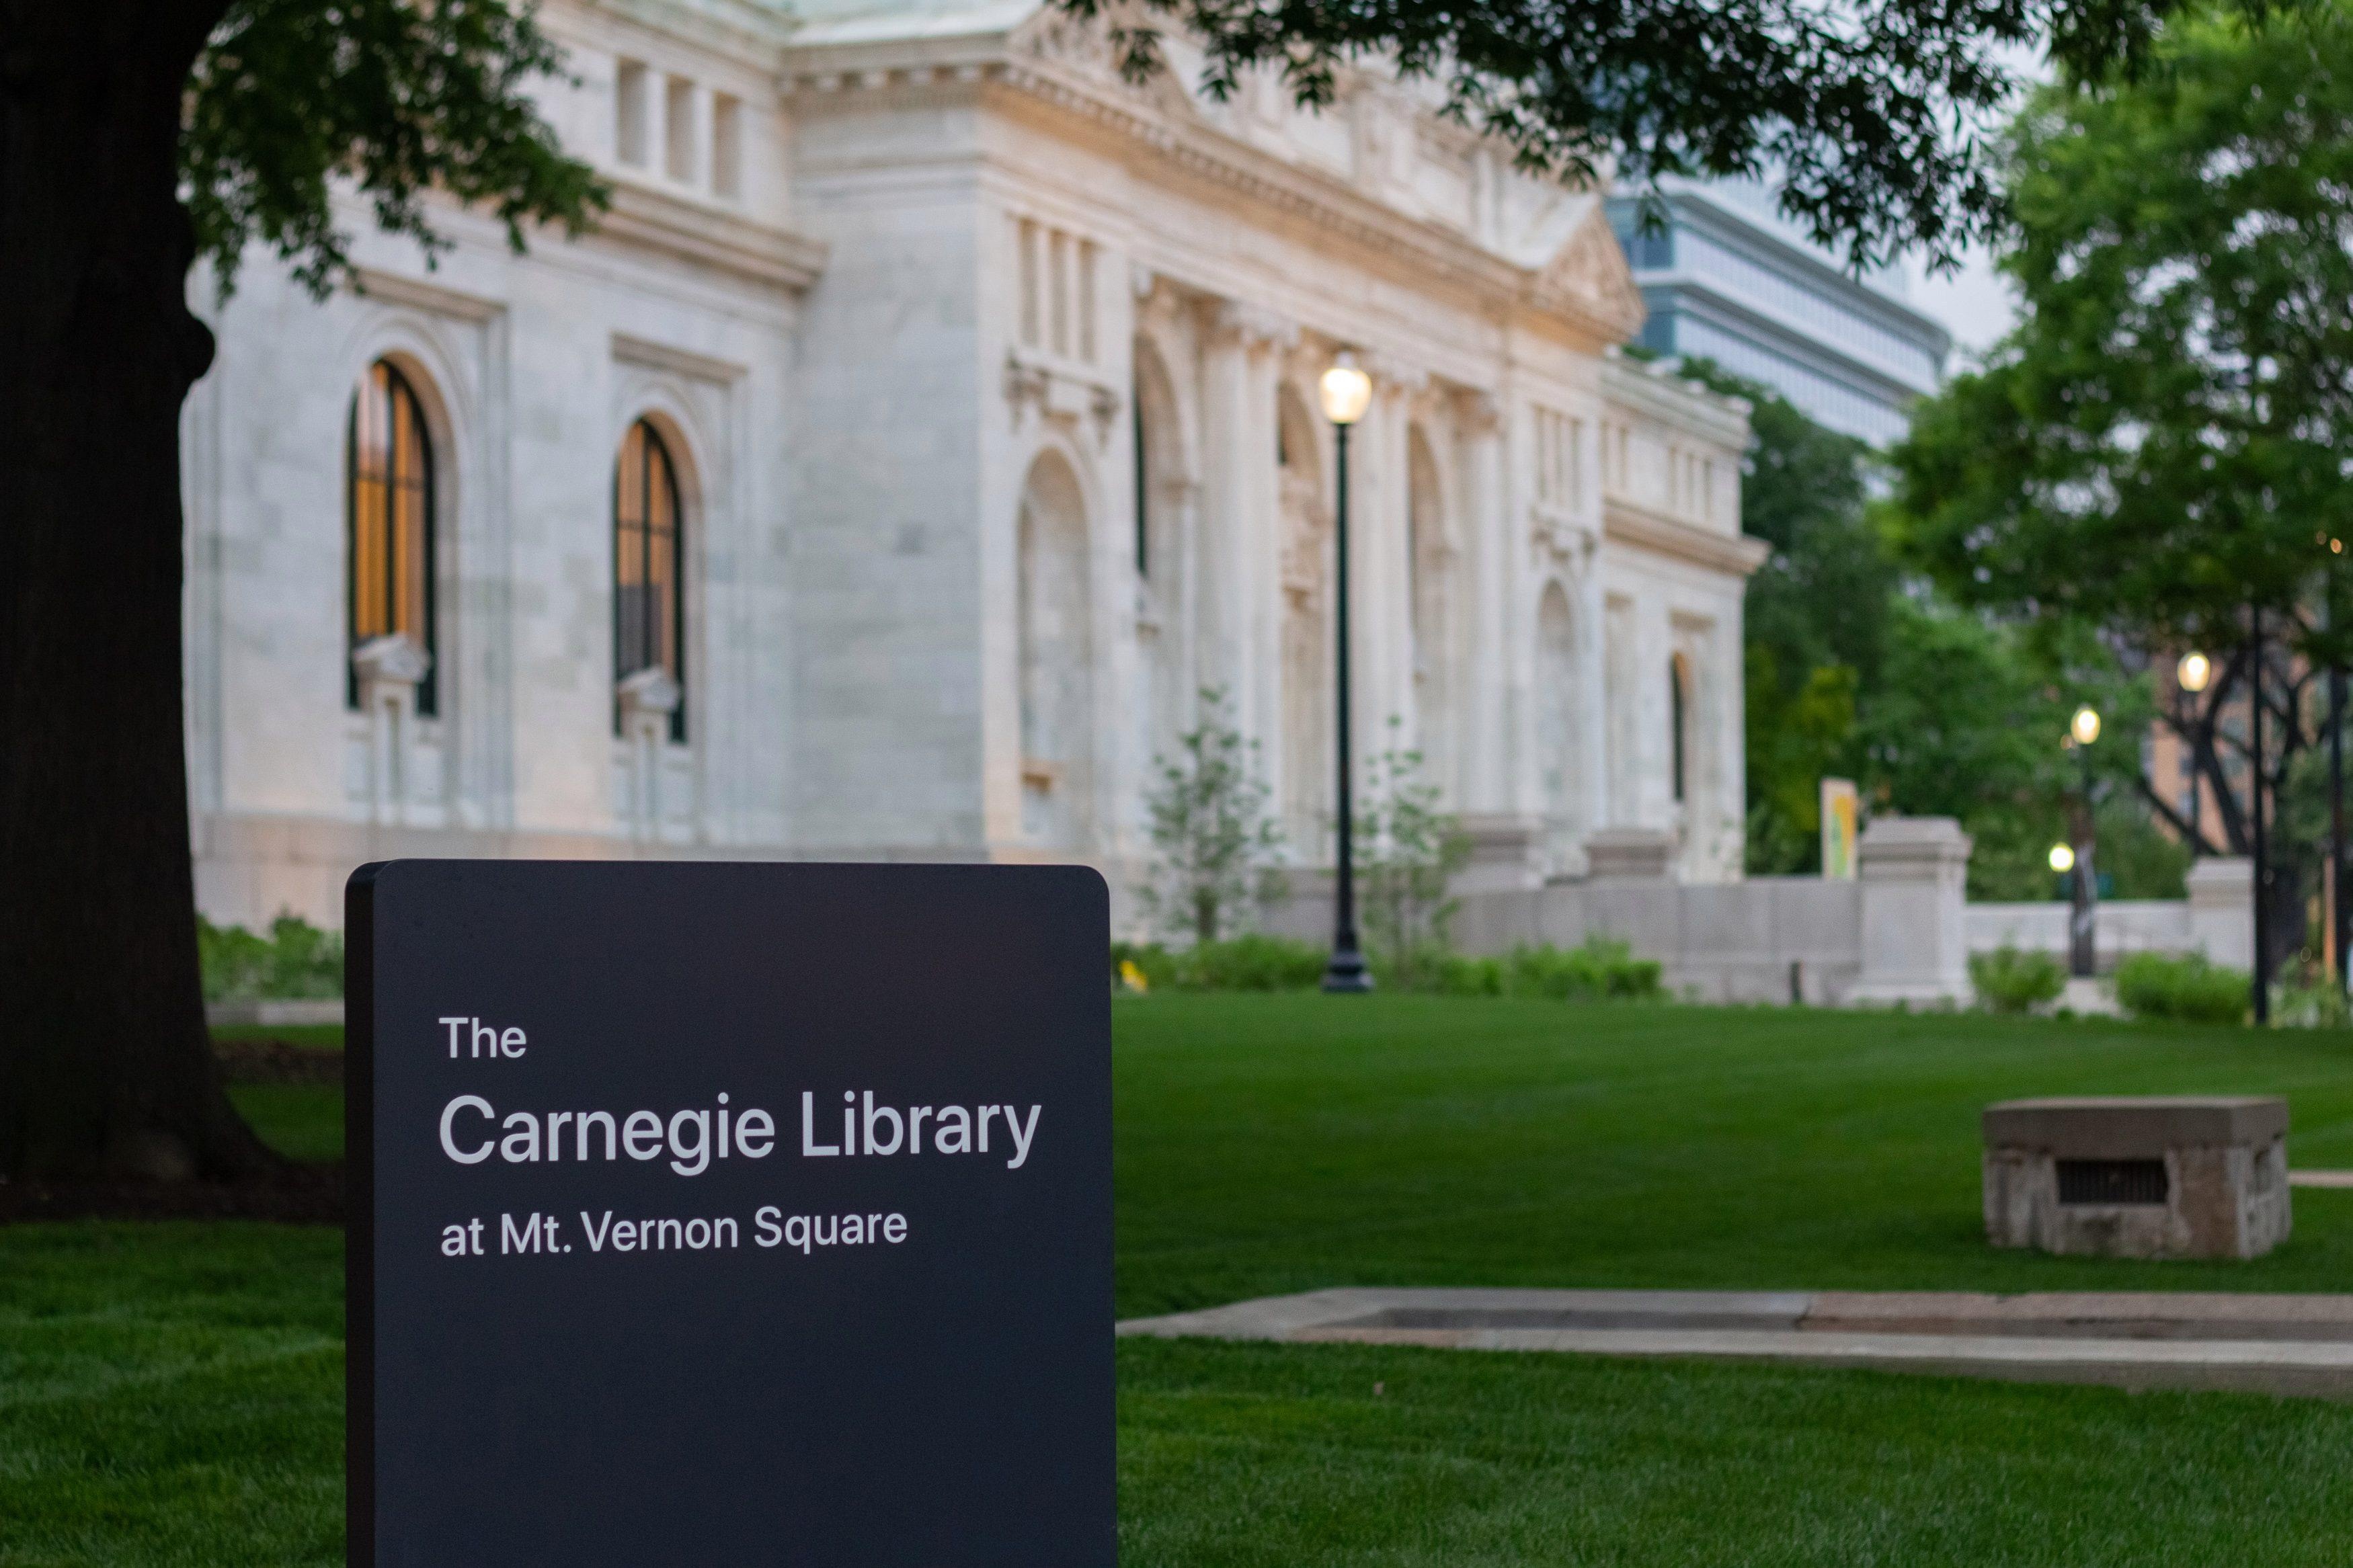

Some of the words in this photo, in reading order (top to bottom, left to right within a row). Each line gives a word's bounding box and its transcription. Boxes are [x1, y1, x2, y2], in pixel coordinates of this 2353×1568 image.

[438, 1017, 527, 1059] The
[440, 1091, 775, 1176] Carnegie
[802, 1090, 1042, 1169] Library
[441, 1218, 484, 1256] at
[502, 1212, 571, 1254] Mt.
[580, 1210, 738, 1252] Vernon
[754, 1206, 908, 1254] Square
